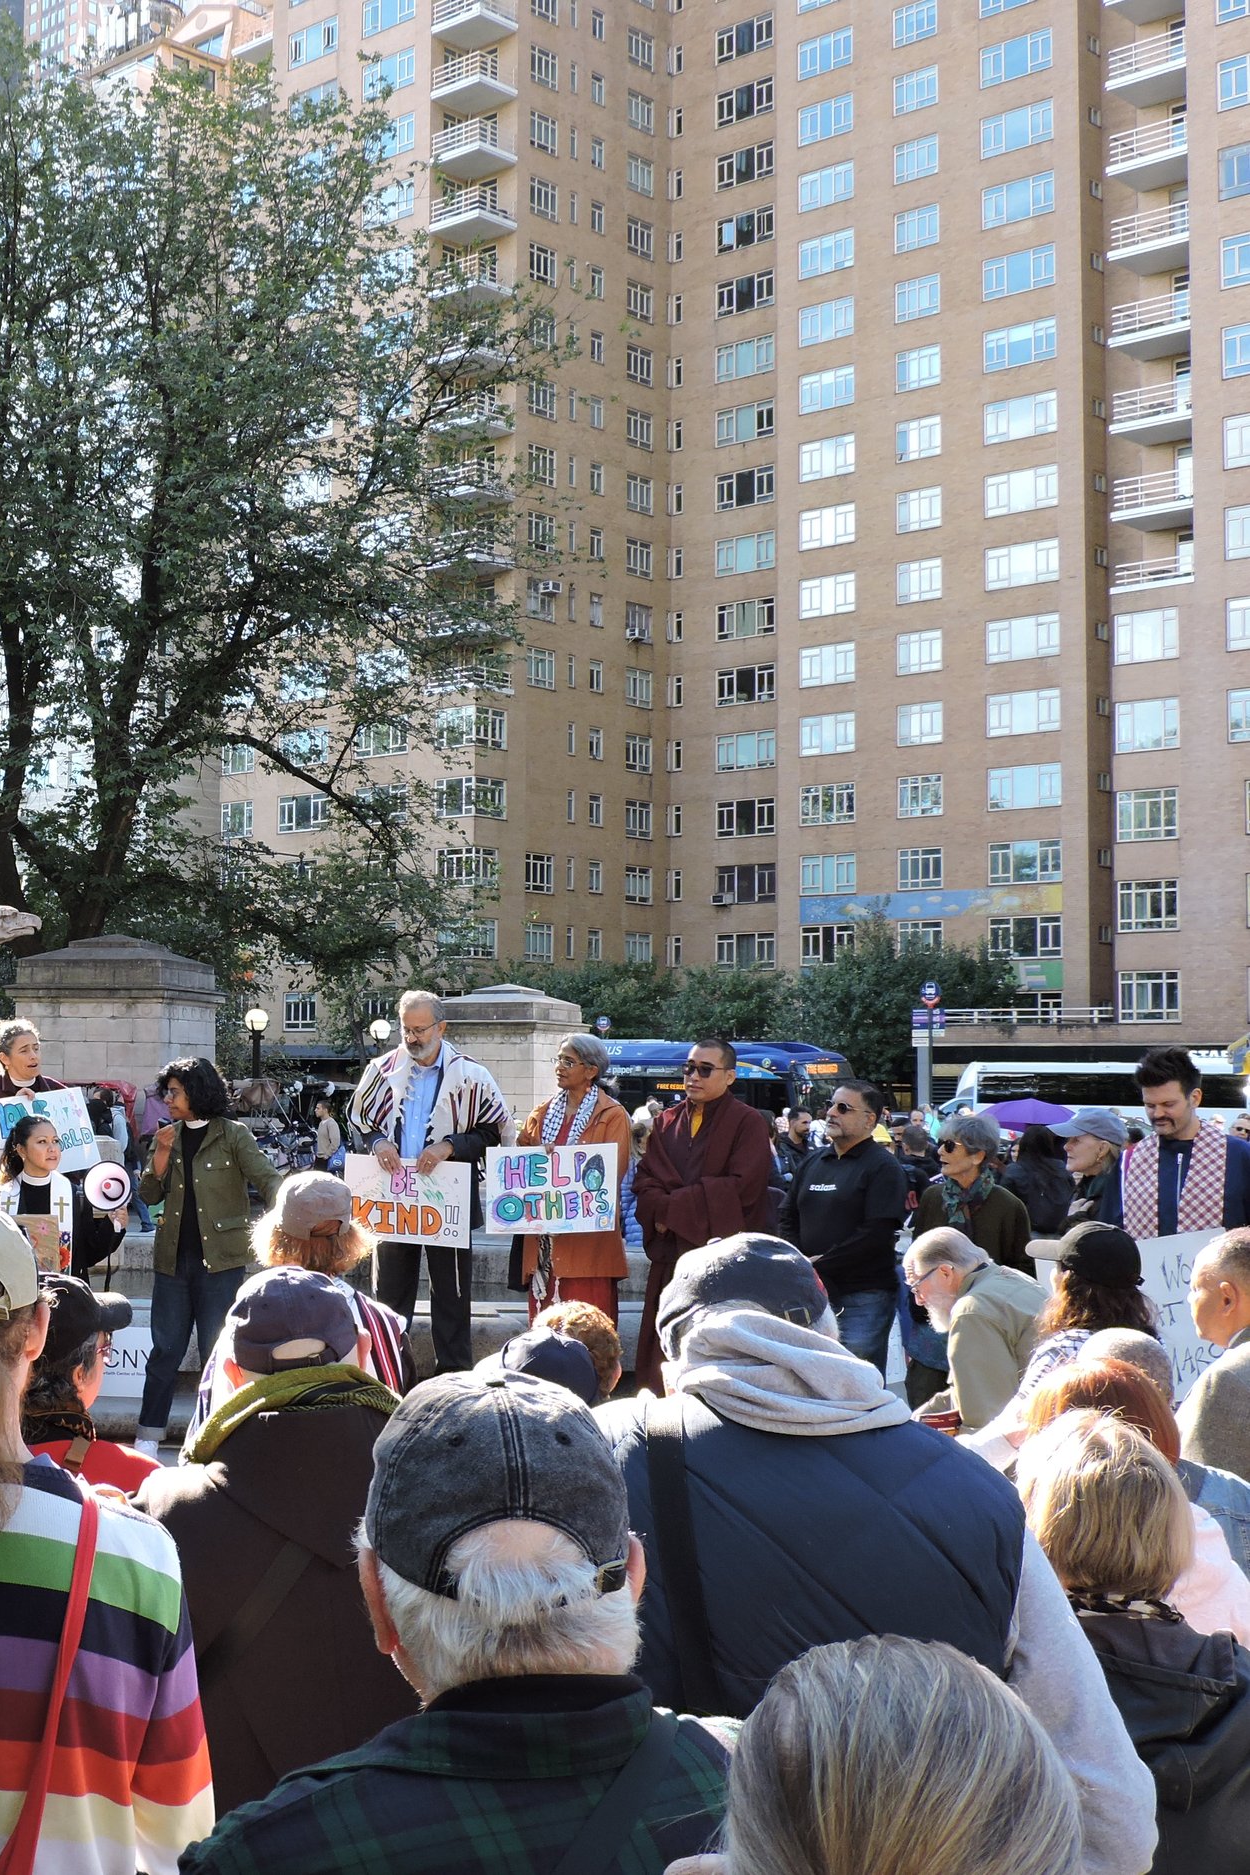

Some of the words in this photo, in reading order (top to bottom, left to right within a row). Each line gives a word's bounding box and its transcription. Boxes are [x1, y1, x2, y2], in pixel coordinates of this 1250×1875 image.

[390, 1165, 419, 1197] BE
[504, 1151, 587, 1190] HELP
[497, 1188, 610, 1222] OTHERS
